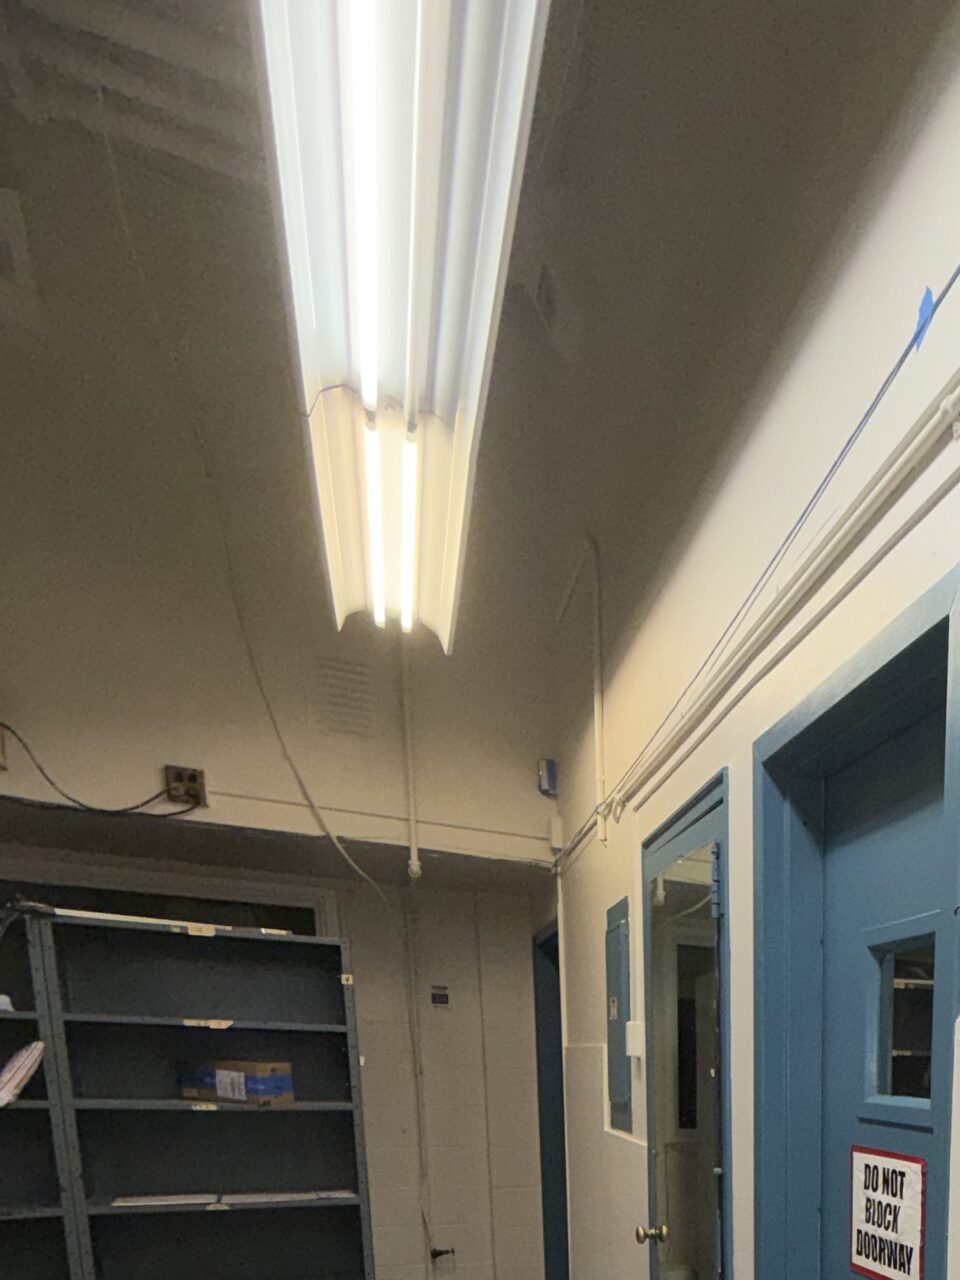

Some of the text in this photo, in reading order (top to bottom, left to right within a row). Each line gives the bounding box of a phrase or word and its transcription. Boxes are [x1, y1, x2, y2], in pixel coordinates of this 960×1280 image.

[864, 1163, 906, 1200] DO NOT
[865, 1197, 901, 1234] BLOCK
[856, 1229, 914, 1276] DOORWAY
